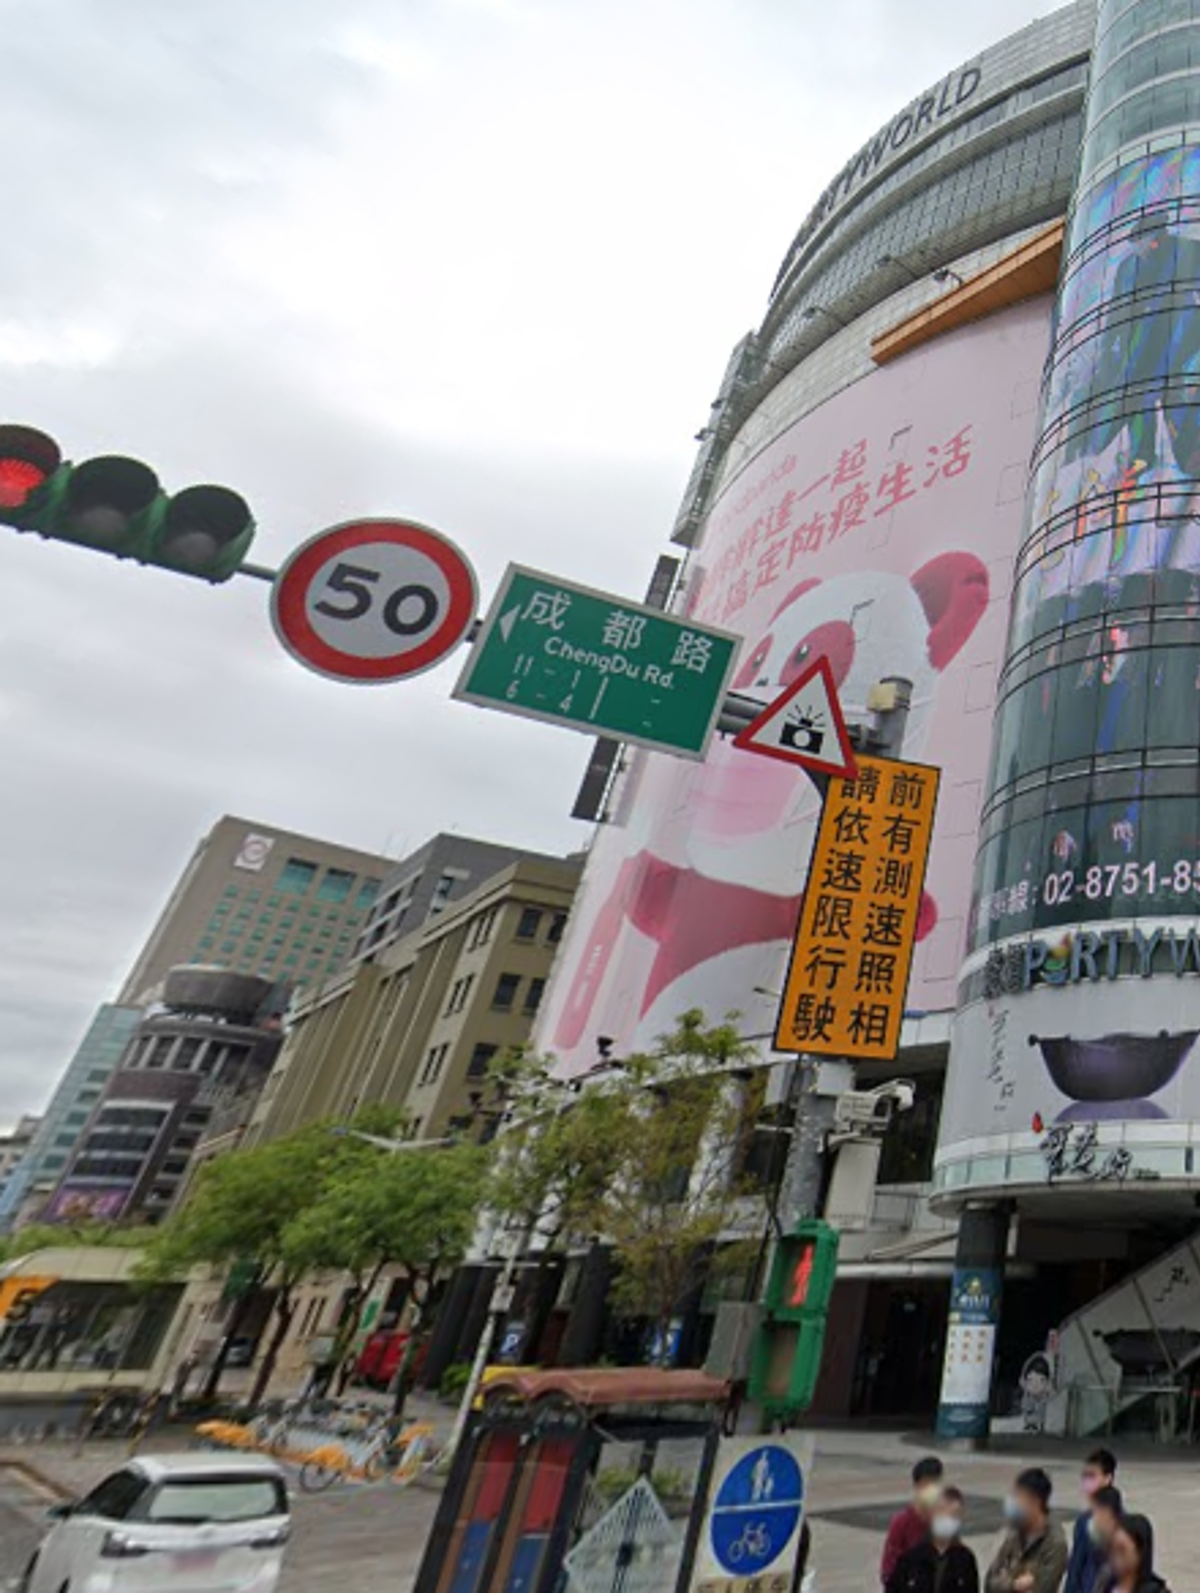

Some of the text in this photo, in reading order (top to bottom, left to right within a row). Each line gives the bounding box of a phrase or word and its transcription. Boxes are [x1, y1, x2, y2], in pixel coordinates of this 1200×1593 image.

[314, 562, 439, 636] 50
[520, 590, 714, 674] 成都路
[543, 635, 676, 690] ChengDu Rd.
[791, 765, 882, 1043] 請依速限行駛
[846, 770, 927, 1047] 前有測速照相
